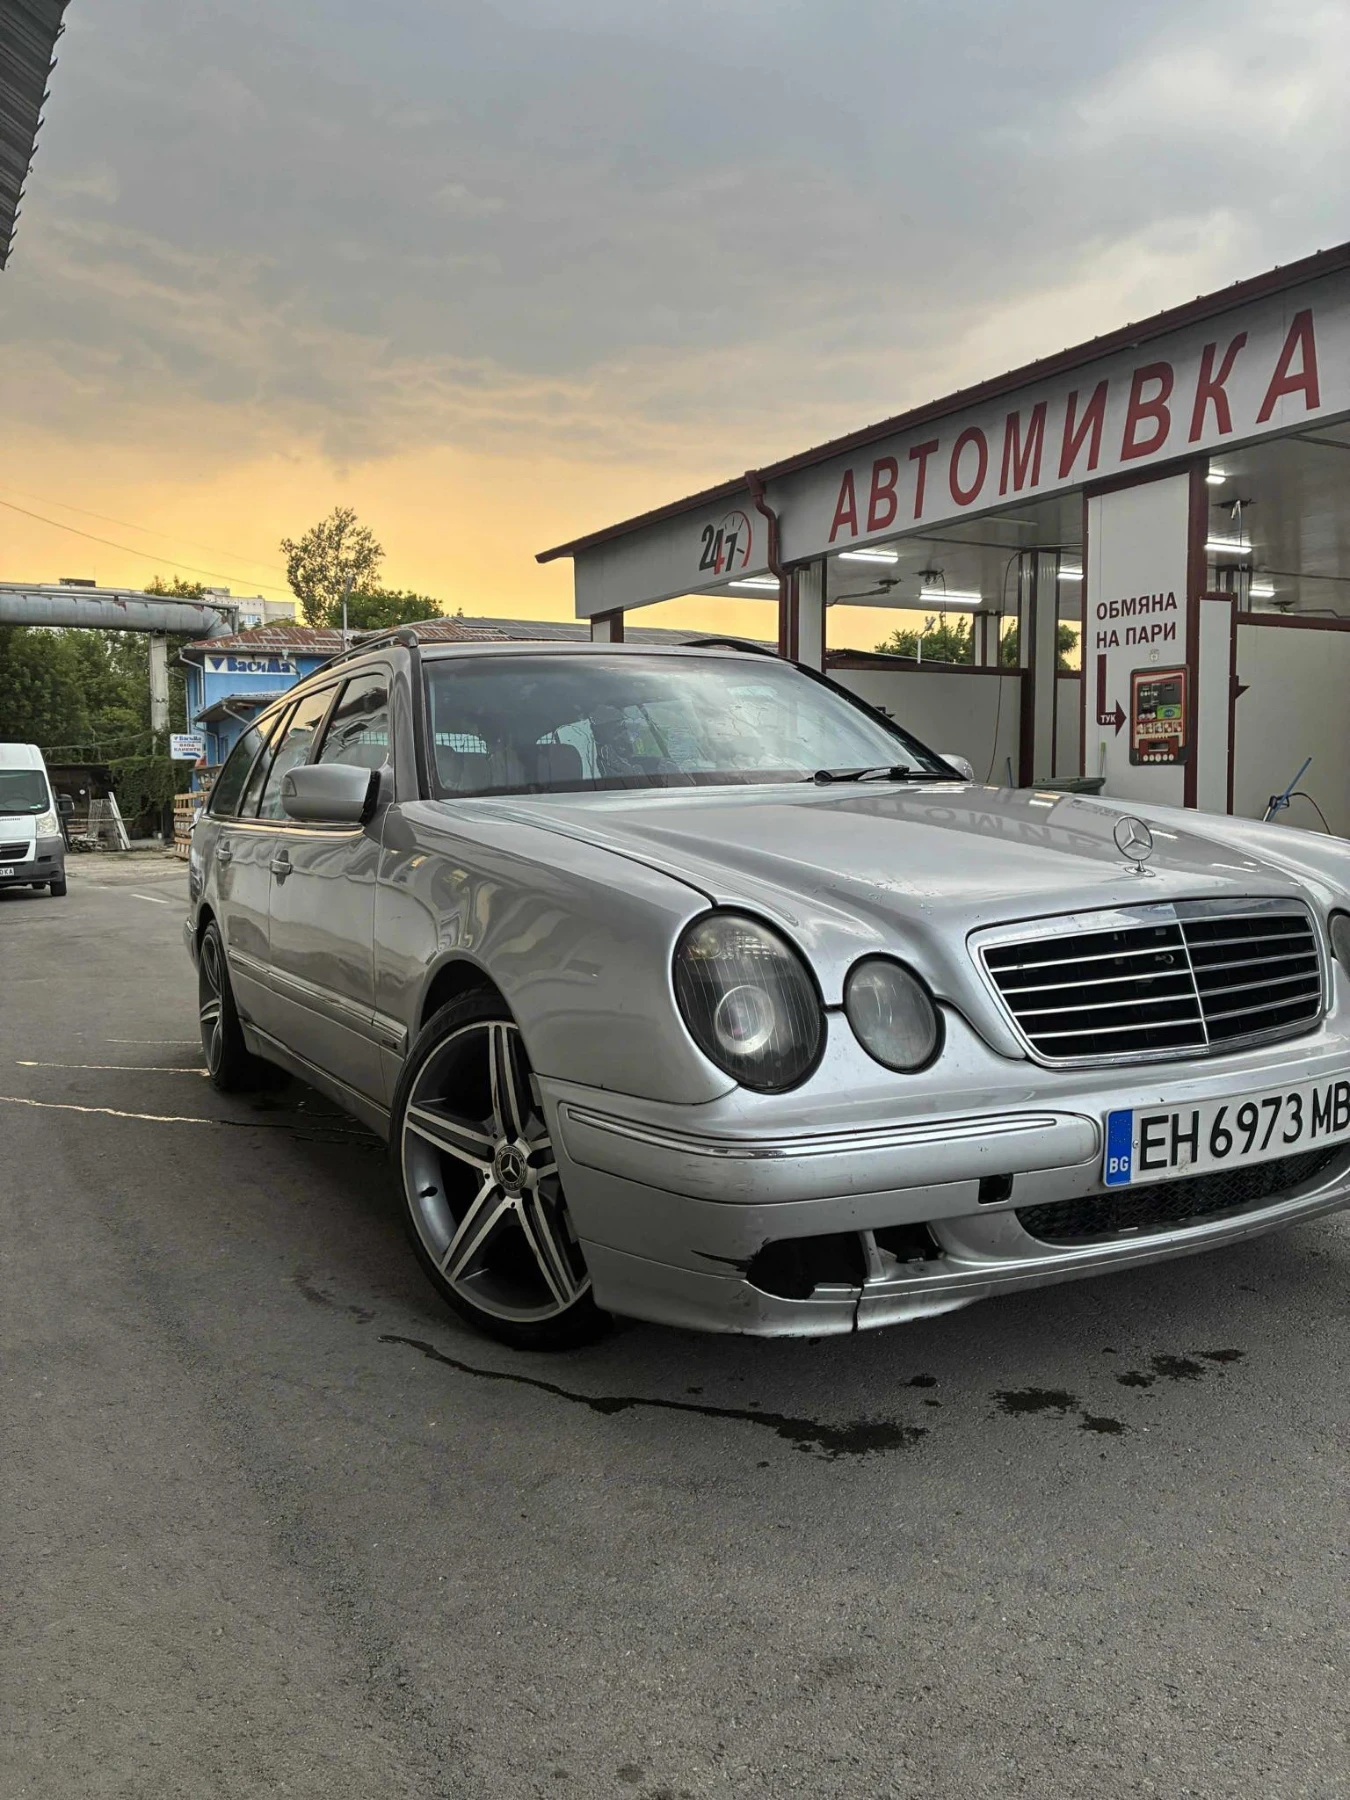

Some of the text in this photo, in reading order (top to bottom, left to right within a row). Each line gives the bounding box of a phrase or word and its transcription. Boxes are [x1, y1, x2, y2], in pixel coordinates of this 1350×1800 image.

[828, 308, 1321, 543] АВТОМИВКА
[1096, 592, 1178, 620] ОБМЯНА
[1096, 622, 1176, 649] НА ПАРИ
[1100, 714, 1116, 723] ТУК
[1139, 1081, 1350, 1171] EH 6973 MB
[1109, 1156, 1129, 1174] BG
